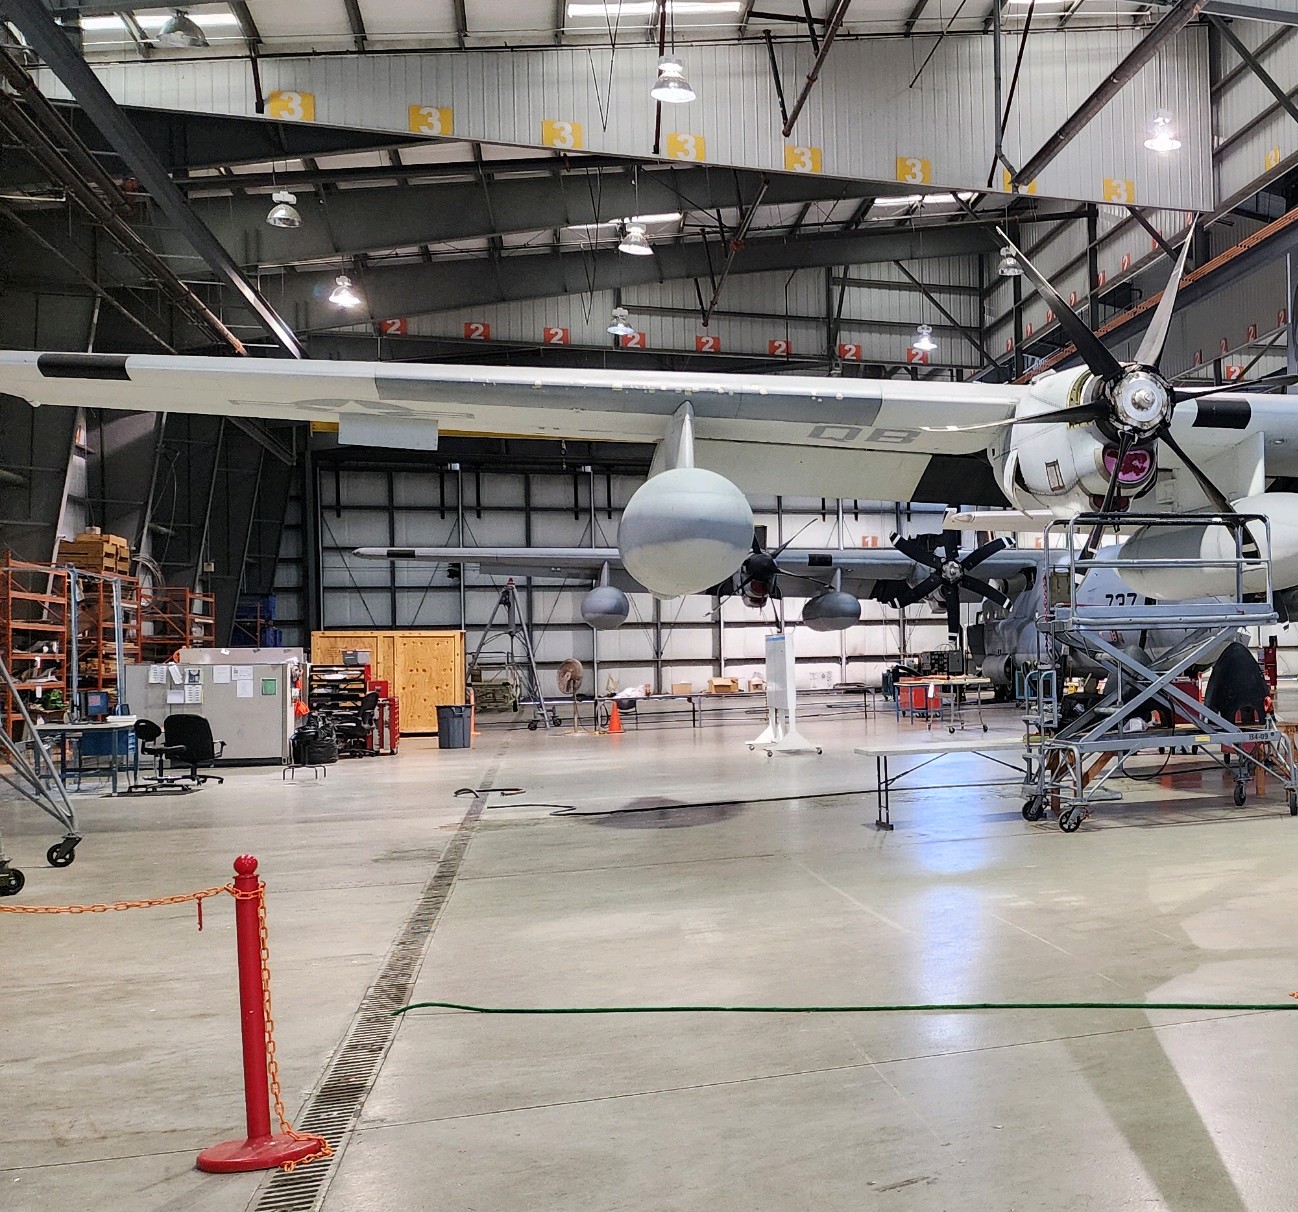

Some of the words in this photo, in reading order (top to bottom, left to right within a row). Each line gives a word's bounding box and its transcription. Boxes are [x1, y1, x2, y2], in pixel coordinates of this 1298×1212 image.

[280, 91, 304, 120] 3
[419, 106, 442, 135] 3
[552, 121, 574, 149] 3
[675, 134, 697, 160] 3
[793, 146, 812, 172] 3
[905, 158, 924, 184] 3
[1111, 179, 1127, 203] 3
[387, 319, 401, 334] 2
[470, 323, 485, 339] 2
[549, 328, 564, 344] 2
[627, 332, 641, 347] 2
[700, 336, 714, 351] 2
[774, 340, 787, 355] 2
[844, 345, 857, 359] 2
[911, 349, 924, 363] 2
[1230, 367, 1240, 379] 2
[1249, 733, 1269, 741] B4-09
